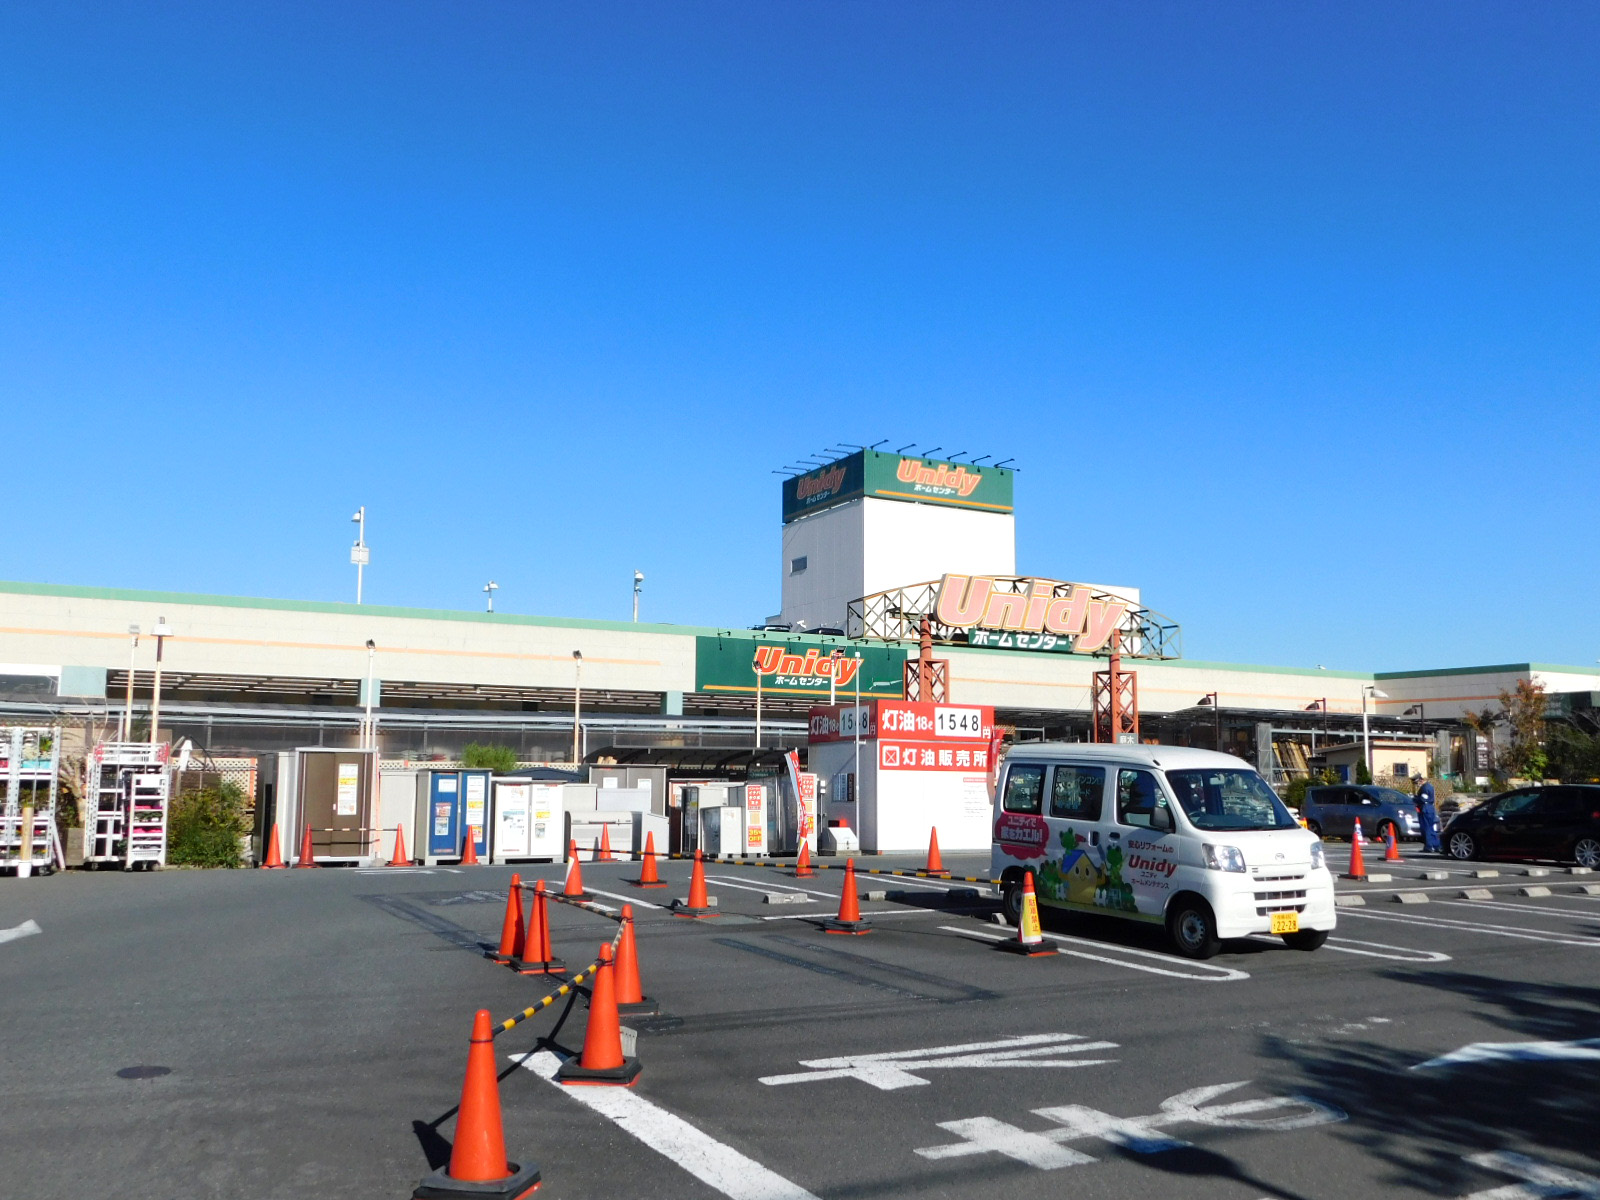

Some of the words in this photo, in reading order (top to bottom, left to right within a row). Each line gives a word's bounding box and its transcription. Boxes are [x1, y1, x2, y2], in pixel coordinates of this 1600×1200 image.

[796, 464, 847, 500] Unidy
[896, 459, 983, 497] Unidy
[913, 484, 956, 496] ホームセンター
[935, 573, 1128, 652] Unidy
[972, 630, 1068, 650] ホームセンター
[751, 645, 865, 687] Unidy
[774, 676, 829, 687] ホームセンター
[937, 713, 980, 732] 1548
[982, 726, 991, 740] 円
[902, 747, 987, 768] 灯油販売所
[1128, 840, 1174, 853] 安心リフォームの
[1128, 854, 1178, 878] Unidy
